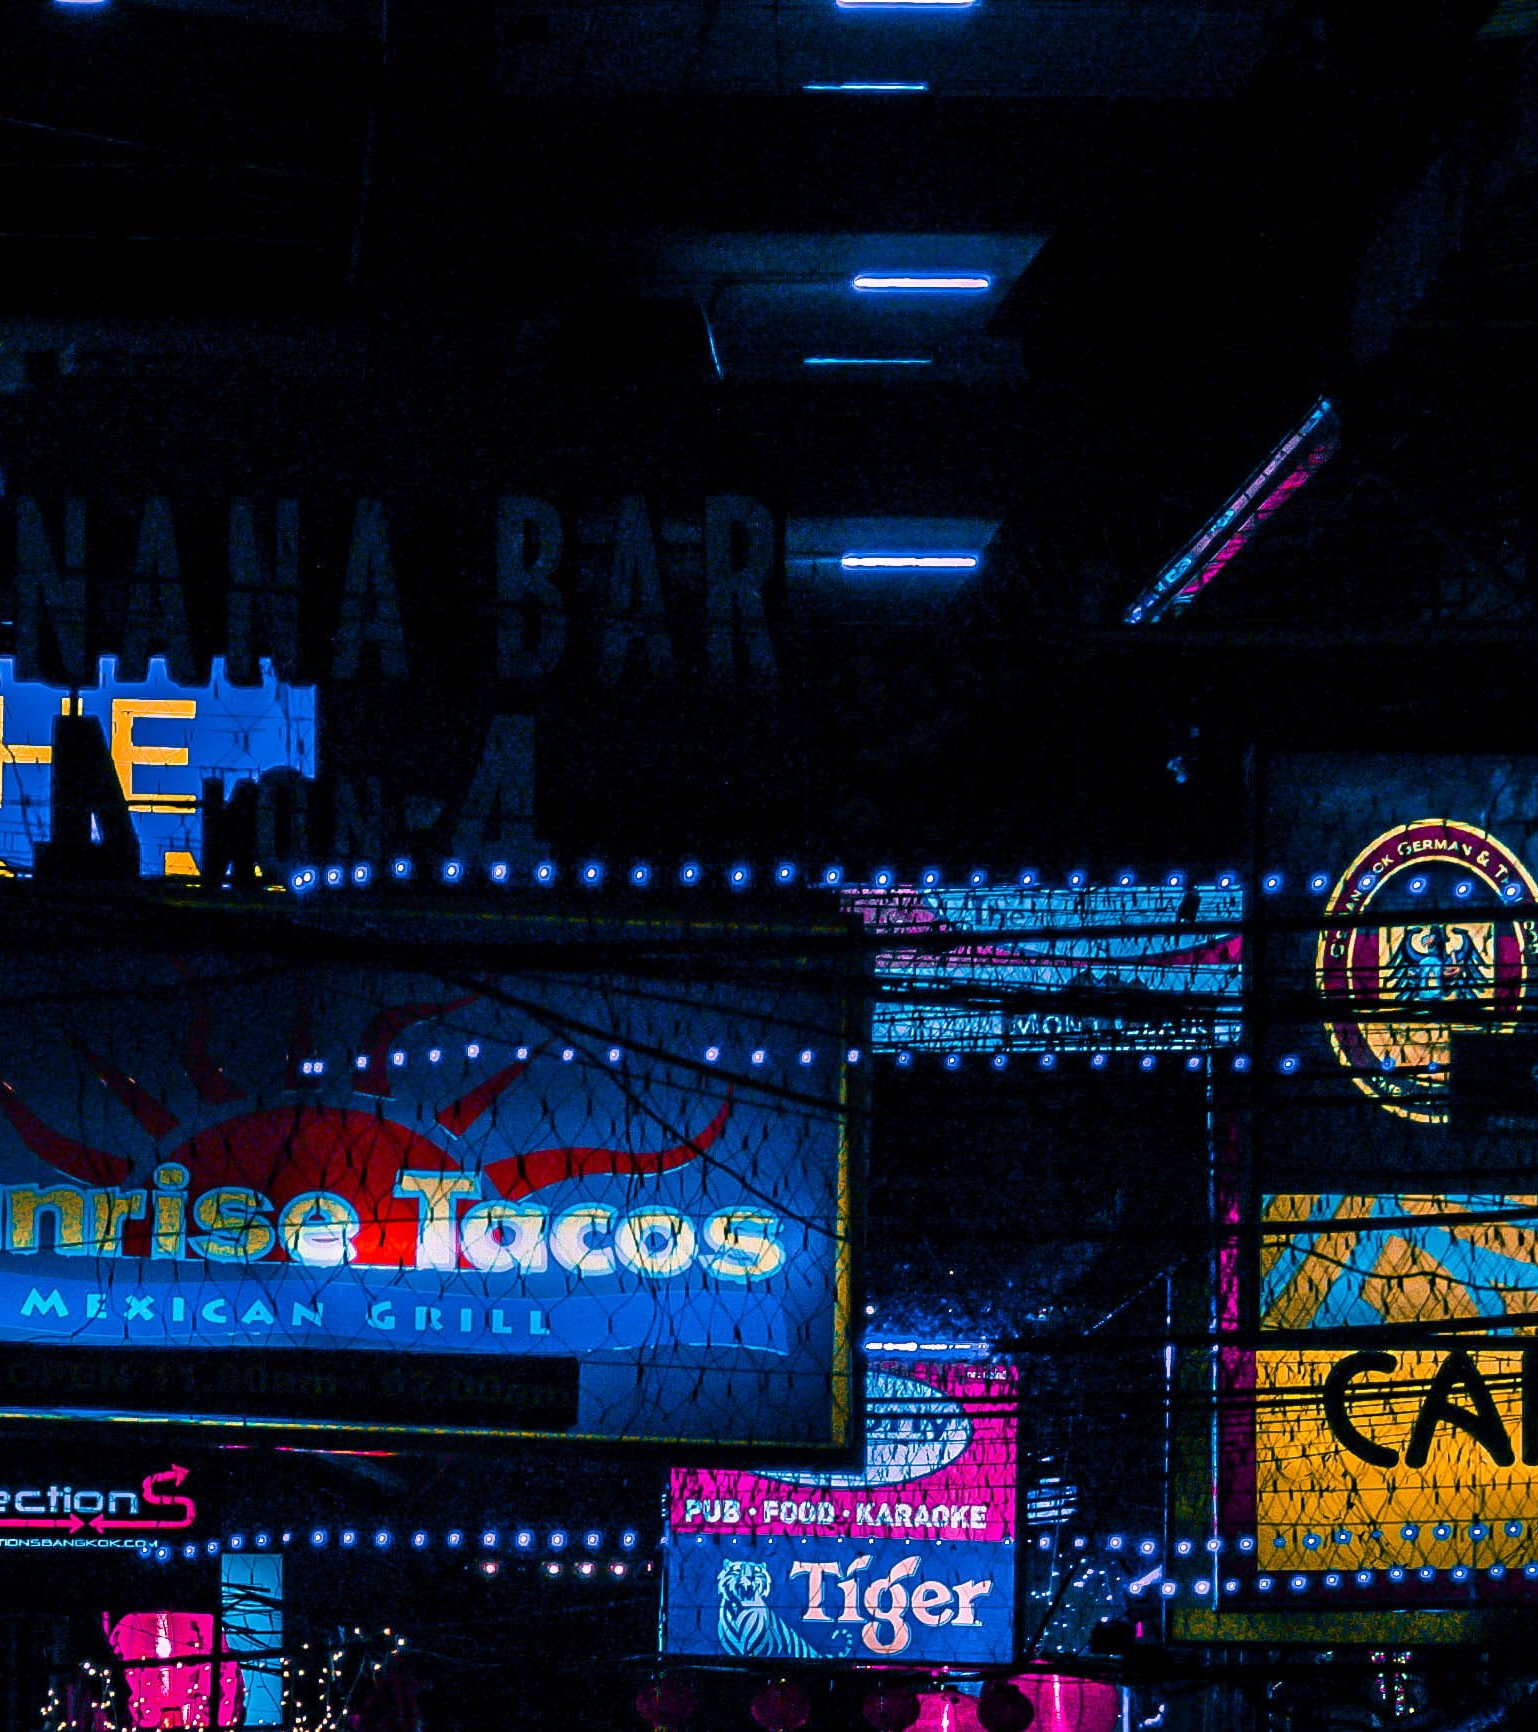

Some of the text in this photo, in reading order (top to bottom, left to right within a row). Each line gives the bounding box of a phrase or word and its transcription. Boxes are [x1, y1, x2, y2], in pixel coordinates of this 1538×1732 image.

[495, 493, 779, 681] BAR
[396, 1168, 786, 1285] Tacos
[20, 1287, 554, 1337] MEXICAN GRILL
[684, 1499, 988, 1530] PUB FOOD KARAOKE
[788, 1554, 994, 1656] Tiger
